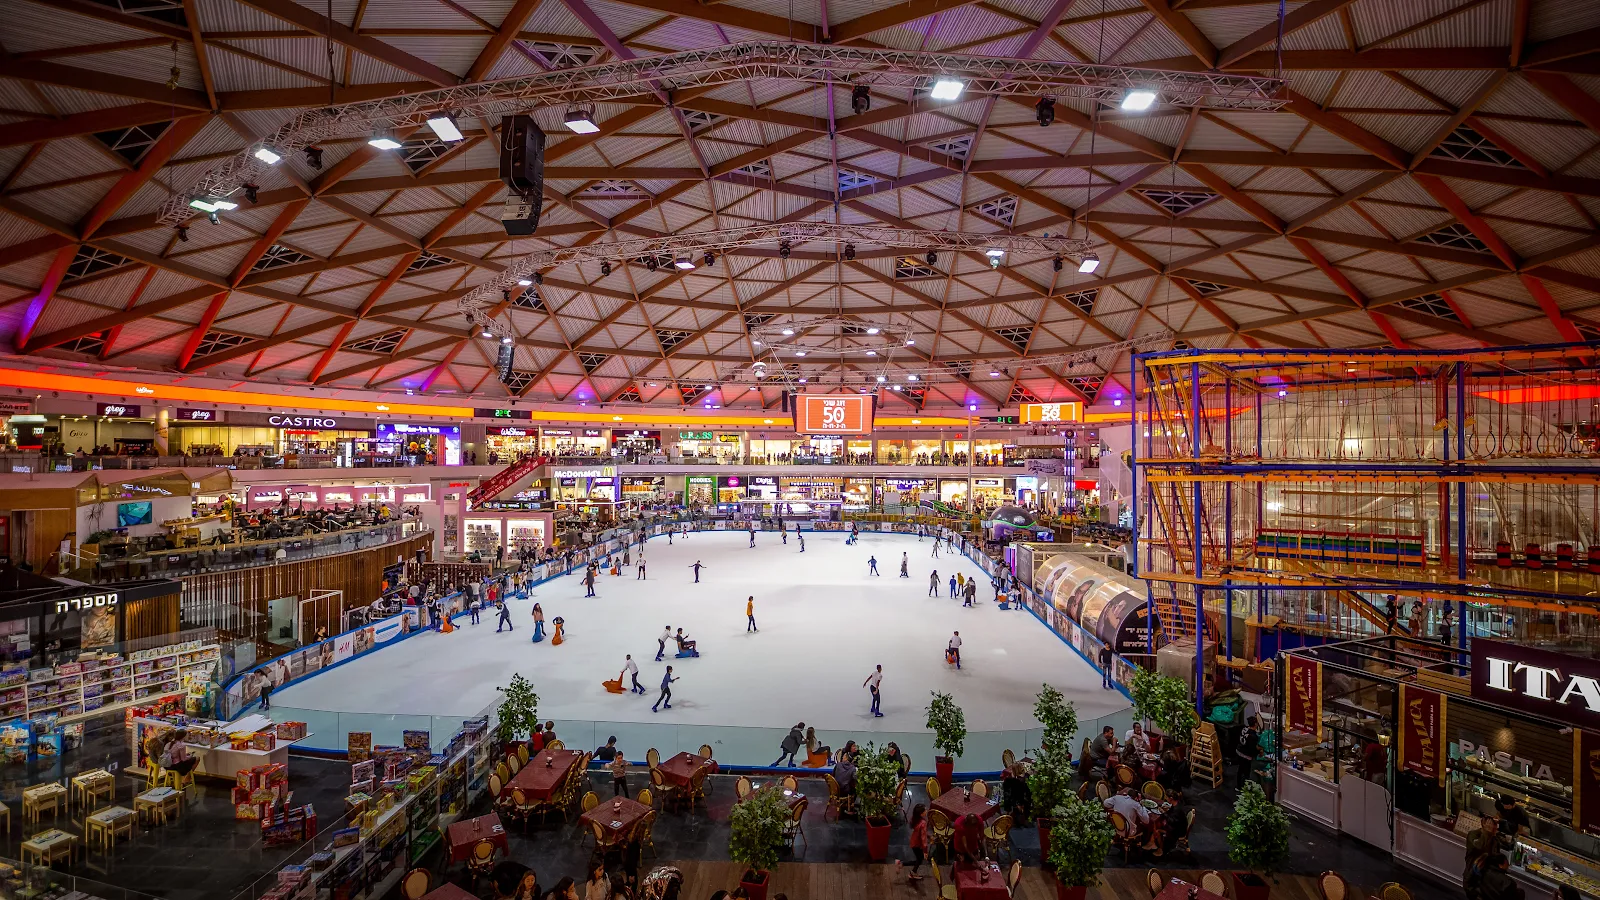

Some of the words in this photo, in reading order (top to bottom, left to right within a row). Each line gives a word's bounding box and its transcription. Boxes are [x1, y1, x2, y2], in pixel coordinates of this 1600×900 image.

[105, 405, 125, 416] greg
[192, 410, 210, 419] greg
[269, 416, 336, 427] CASTRO
[501, 427, 526, 436] WeShoes
[56, 593, 118, 613] מספרה
[1486, 657, 1600, 714] ITA
[1293, 667, 1313, 728] ITALICA
[1410, 698, 1433, 766] ITALICA
[1459, 739, 1555, 781] PASTA
